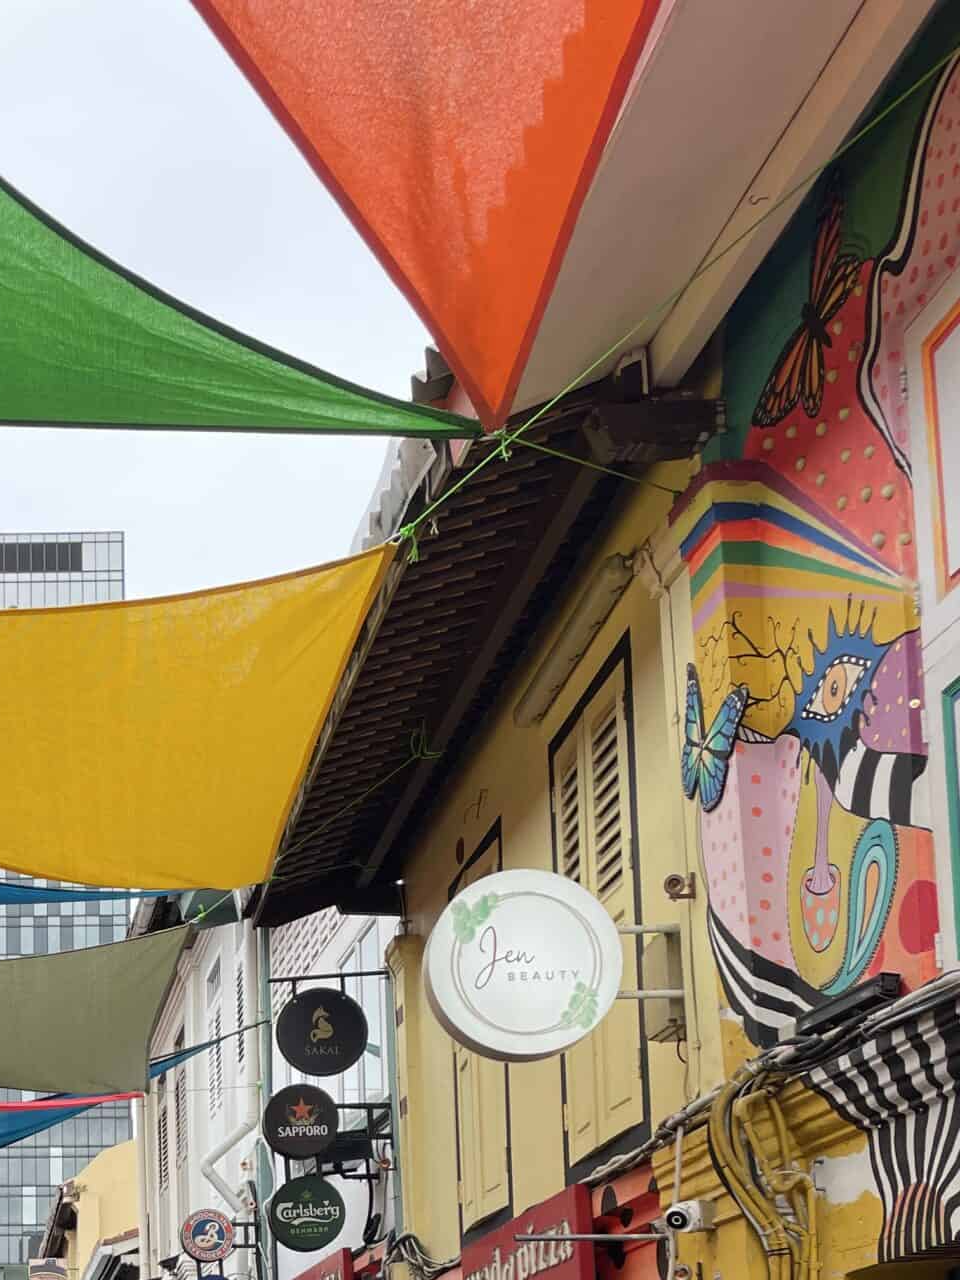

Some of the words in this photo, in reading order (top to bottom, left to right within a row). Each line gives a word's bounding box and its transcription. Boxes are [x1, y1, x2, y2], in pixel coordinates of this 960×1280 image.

[474, 926, 535, 990] Jen
[507, 970, 580, 982] BEAUTY
[277, 1125, 328, 1137] SAPPORO
[276, 1200, 340, 1224] Carlsberg
